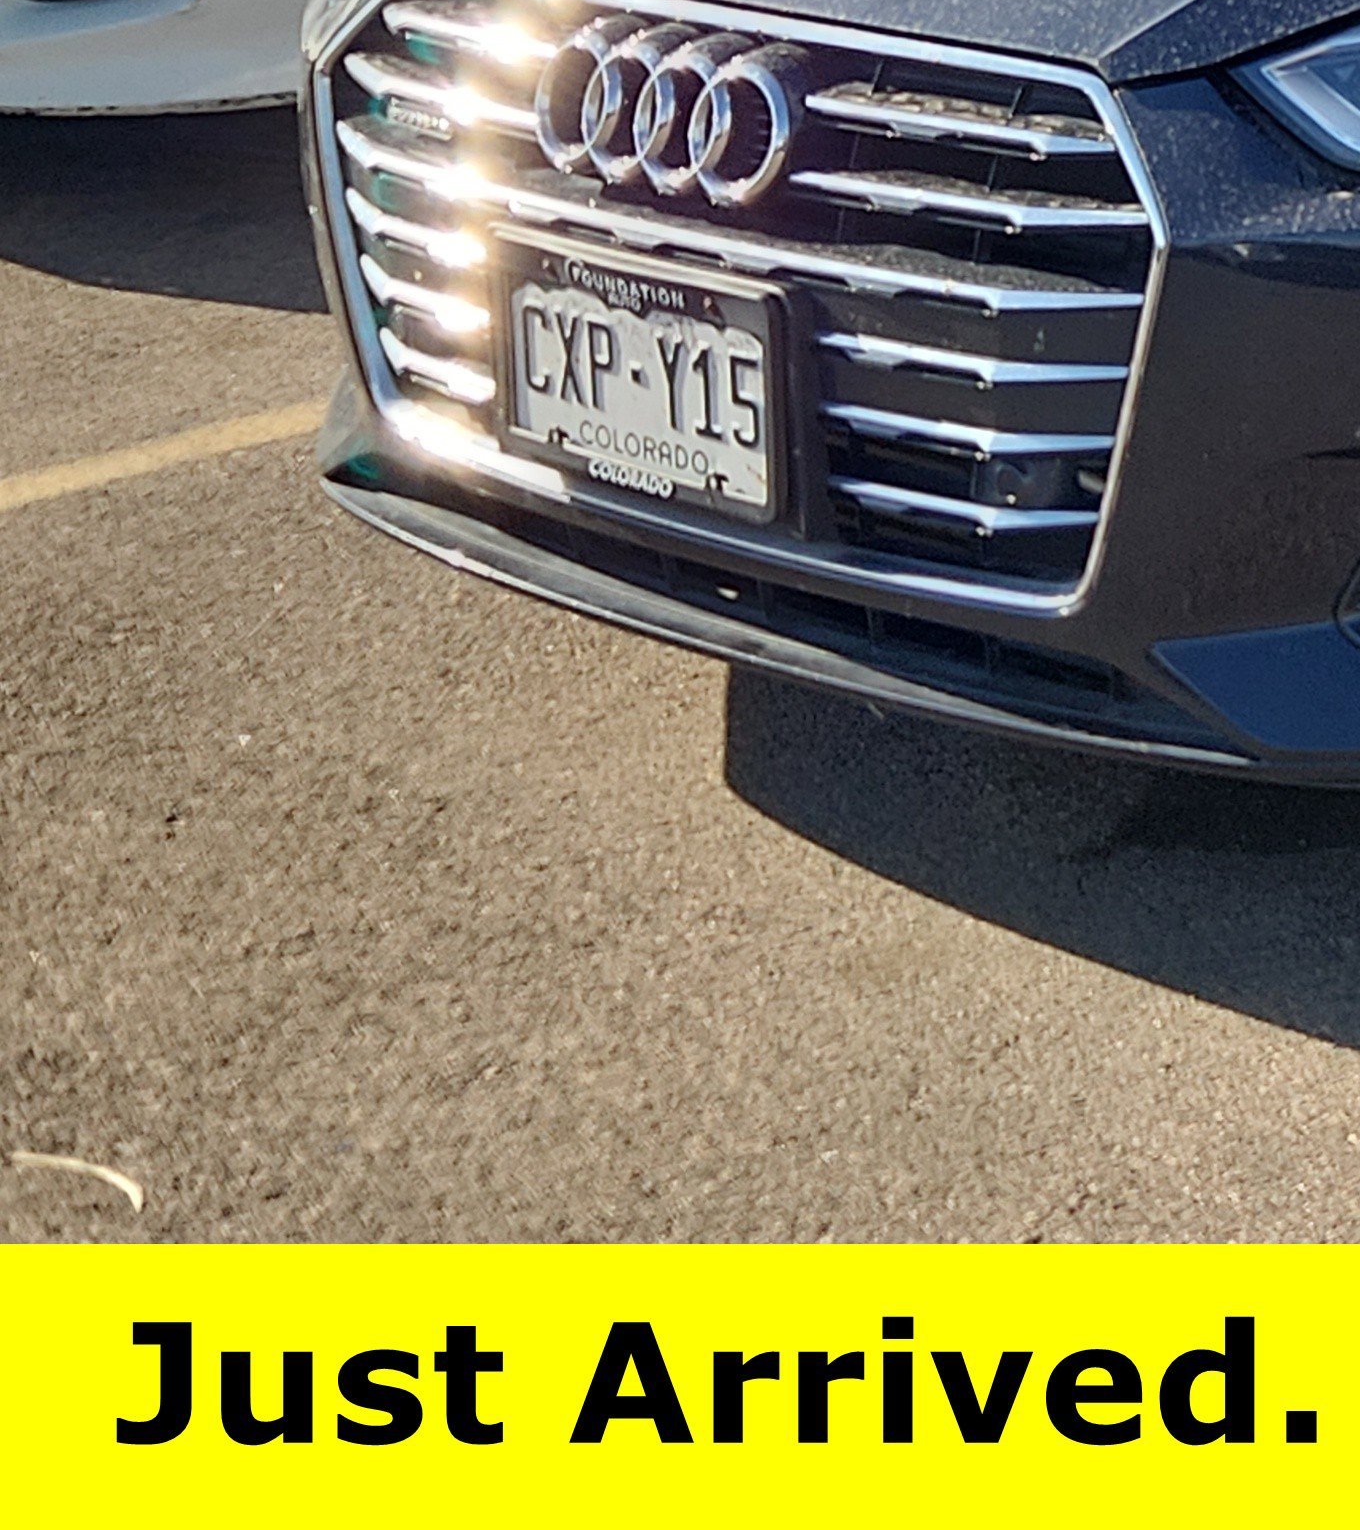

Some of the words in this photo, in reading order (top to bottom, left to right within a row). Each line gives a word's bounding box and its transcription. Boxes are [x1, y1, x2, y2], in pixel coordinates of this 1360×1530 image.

[564, 257, 686, 309] FOUNDATION
[522, 304, 761, 450] CXP-Y15
[578, 419, 710, 476] COLORADO
[587, 458, 675, 501] COLORADO
